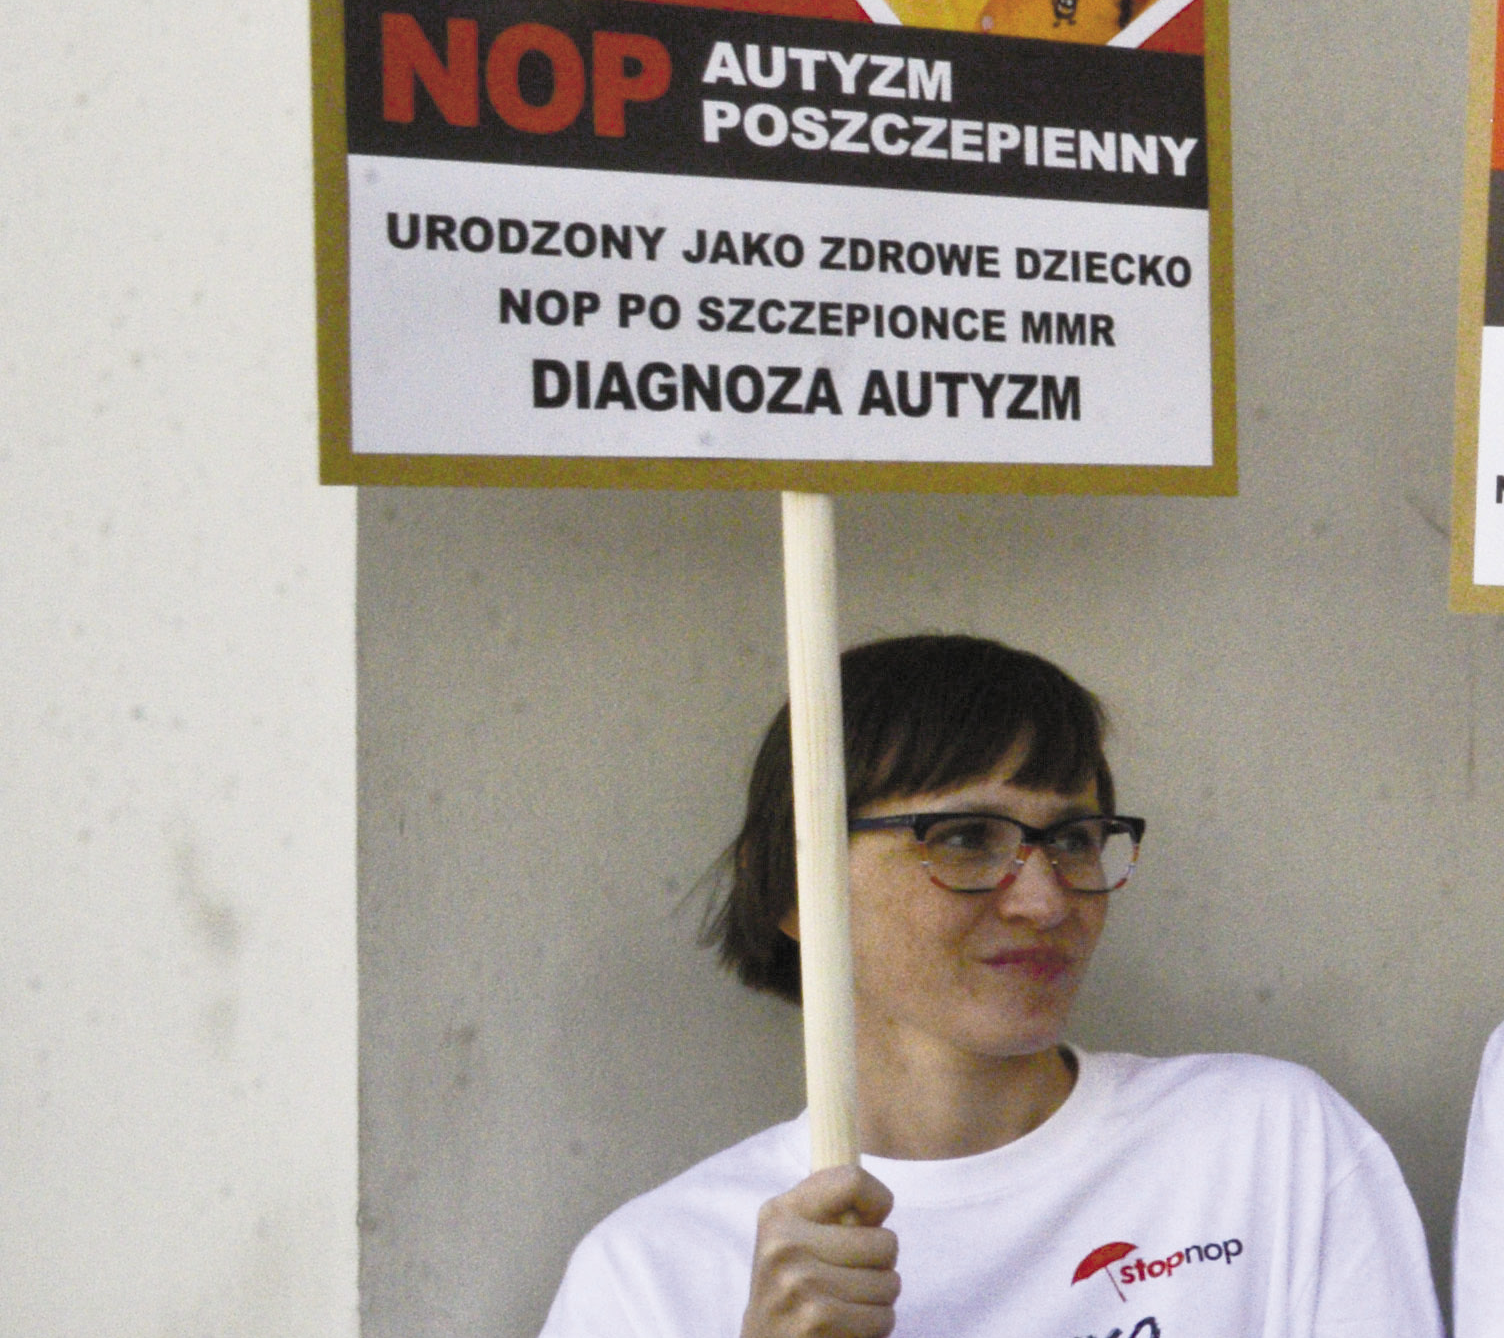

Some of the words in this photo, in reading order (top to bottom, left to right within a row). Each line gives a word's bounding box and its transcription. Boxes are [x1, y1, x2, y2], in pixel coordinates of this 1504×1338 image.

[380, 13, 672, 138] NOP
[703, 43, 953, 103] AUTYZM
[702, 101, 1198, 178] POSZCZEPIENNY
[386, 212, 666, 261] URODZONY
[682, 228, 803, 270] JAKO
[820, 237, 1002, 280] ZDROWE
[1016, 247, 1193, 289] DZIECKO
[499, 288, 601, 327] NOP
[618, 293, 682, 331] PO
[697, 297, 1007, 343] SZCZEPIONCE
[1021, 310, 1116, 347] MMR
[532, 358, 842, 416] DIAGNOZA
[859, 369, 1083, 421] AUTYZM
[1120, 1237, 1244, 1285] stopnop
